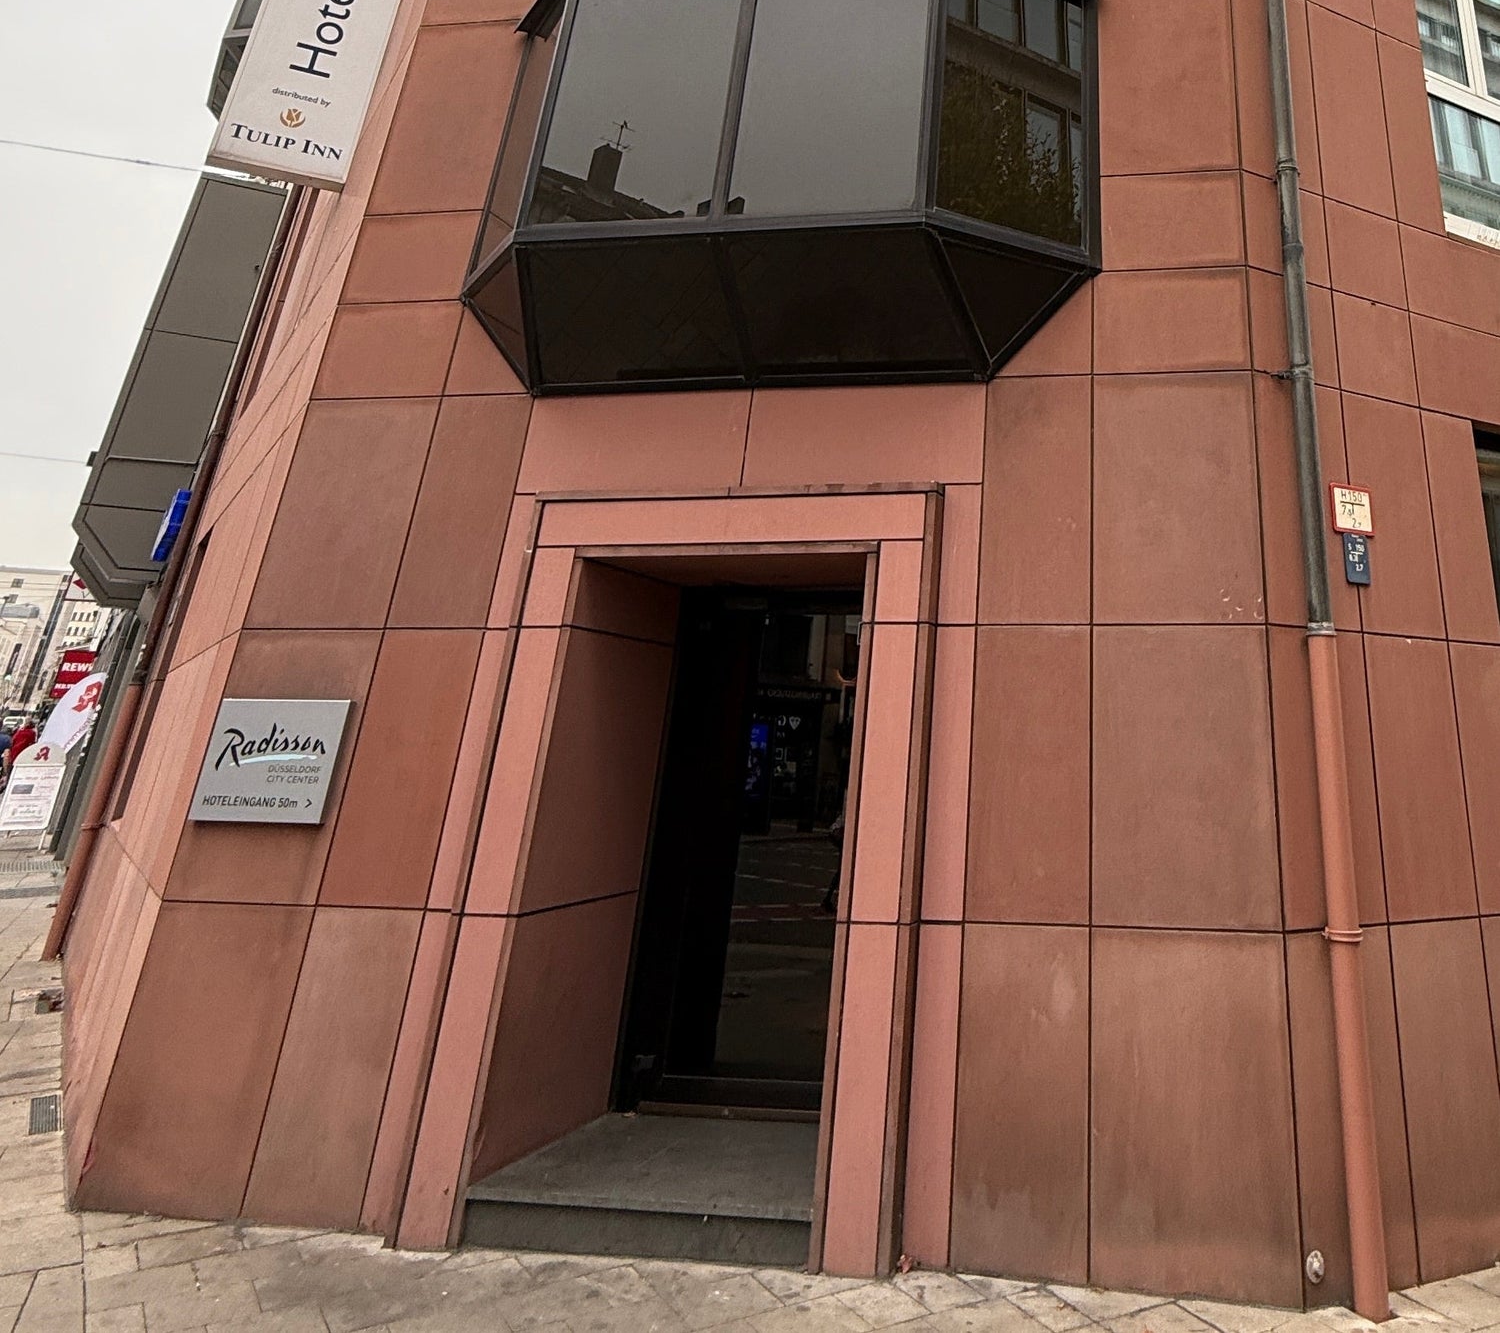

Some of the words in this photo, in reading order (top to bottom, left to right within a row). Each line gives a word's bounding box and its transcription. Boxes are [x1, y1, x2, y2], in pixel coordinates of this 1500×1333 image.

[271, 87, 319, 105] distributed
[319, 97, 332, 108] by
[214, 722, 326, 771] Radisson
[268, 764, 322, 774] DÜSSELDORF
[266, 775, 285, 784] CITY
[286, 775, 319, 784] CENTER
[202, 795, 276, 808] HOTELEINGANG
[277, 798, 298, 808] 50m
